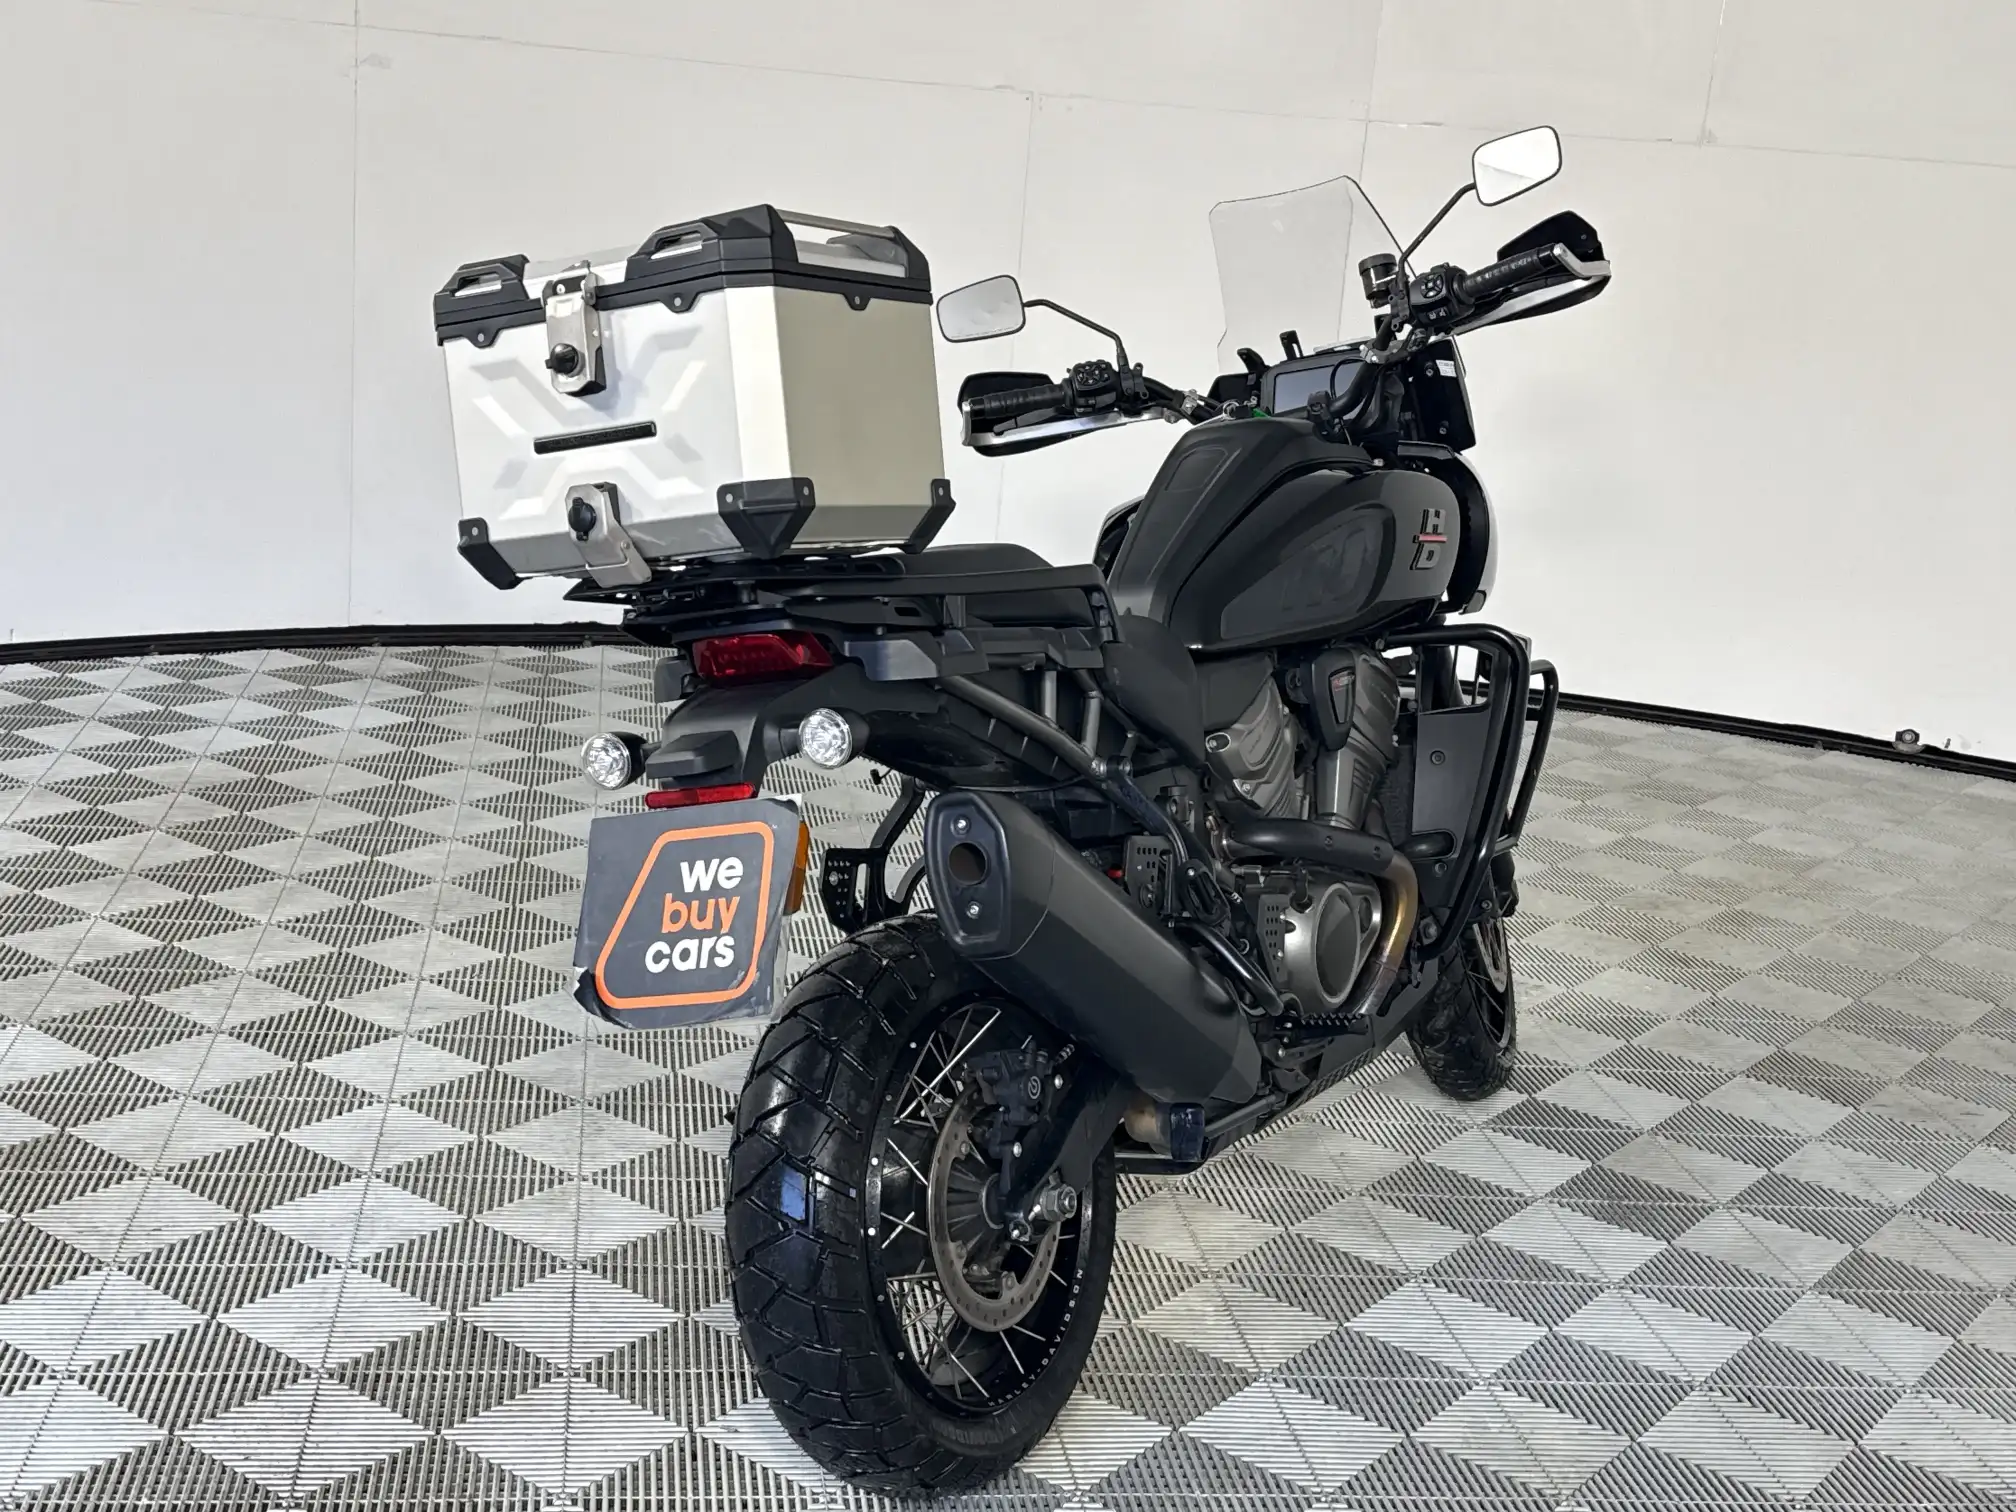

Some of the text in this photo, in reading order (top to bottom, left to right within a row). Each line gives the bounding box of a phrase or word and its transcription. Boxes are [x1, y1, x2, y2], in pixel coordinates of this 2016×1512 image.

[1420, 508, 1446, 534] H
[1409, 542, 1441, 570] D
[680, 856, 744, 893] we
[661, 893, 741, 934] buy
[644, 934, 735, 974] cars
